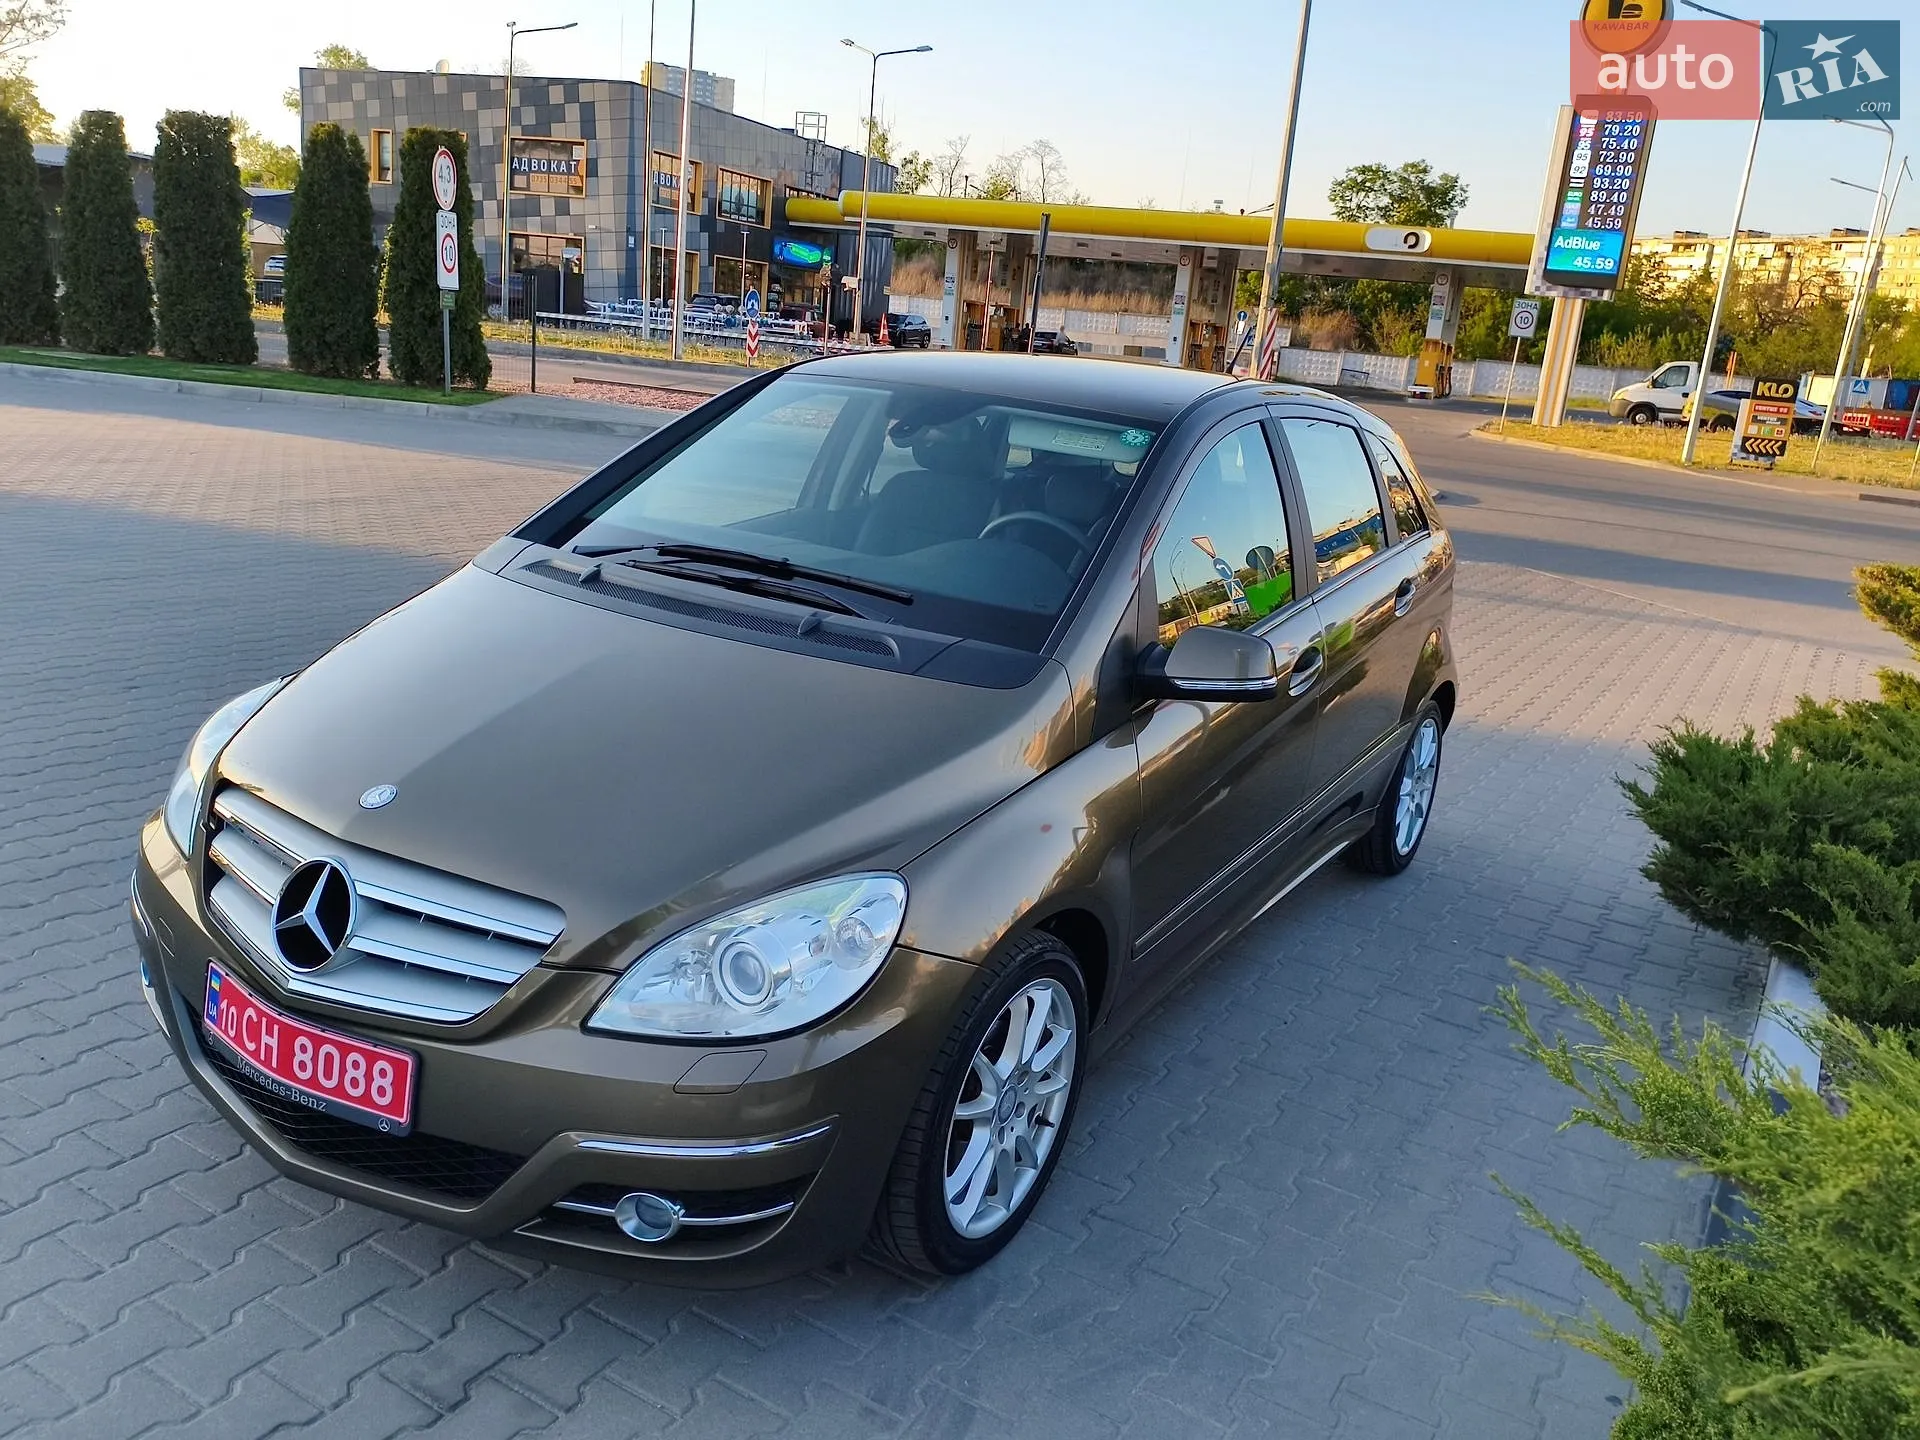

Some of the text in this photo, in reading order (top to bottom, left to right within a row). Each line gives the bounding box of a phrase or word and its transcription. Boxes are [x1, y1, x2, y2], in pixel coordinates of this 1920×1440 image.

[1594, 22, 1649, 31] KAWABAR
[1606, 111, 1643, 122] 83.50
[1604, 124, 1640, 136] 79.20
[1602, 138, 1638, 149] 75.40
[1576, 151, 1635, 163] 95 72.90
[512, 157, 576, 173] АДВОКАТ
[1573, 164, 1632, 176] 92 69.90
[1593, 177, 1630, 190] 93.20
[1590, 191, 1627, 203] 89.40
[1587, 204, 1625, 216] 47.49
[1585, 217, 1622, 229] 45.59
[1554, 235, 1600, 250] AdBlue
[444, 245, 454, 262] 10
[1573, 256, 1614, 270] 45.59
[1515, 301, 1538, 310] ЗОНА
[1520, 316, 1530, 325] 10
[1757, 381, 1794, 398] KLO
[208, 1001, 218, 1020] UA
[220, 998, 394, 1106] 10 CH 8088
[237, 1056, 328, 1112] Mercedes-Benz
